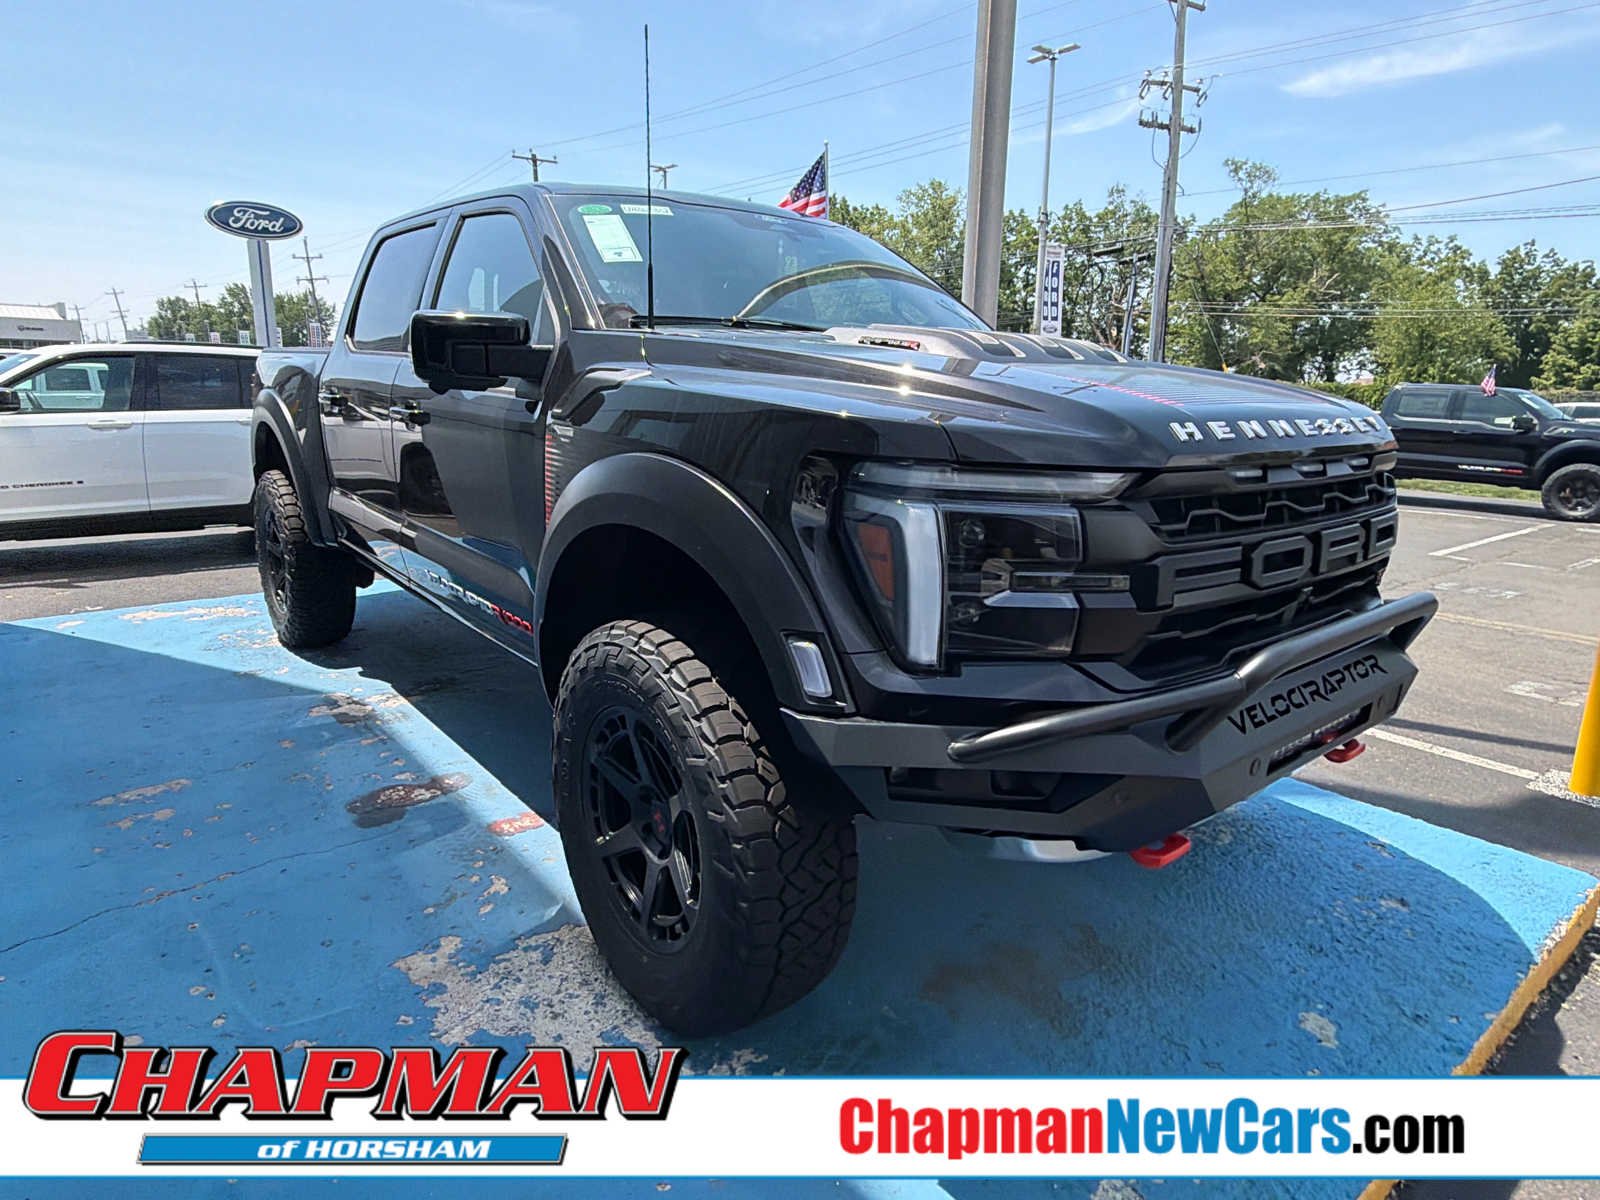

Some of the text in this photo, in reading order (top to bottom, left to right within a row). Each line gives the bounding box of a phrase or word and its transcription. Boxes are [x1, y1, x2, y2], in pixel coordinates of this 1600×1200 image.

[228, 206, 285, 232] Ford
[1051, 262, 1059, 317] FORD
[1150, 511, 1399, 611] FORD
[1227, 654, 1389, 735] VELOCIRAPTOR
